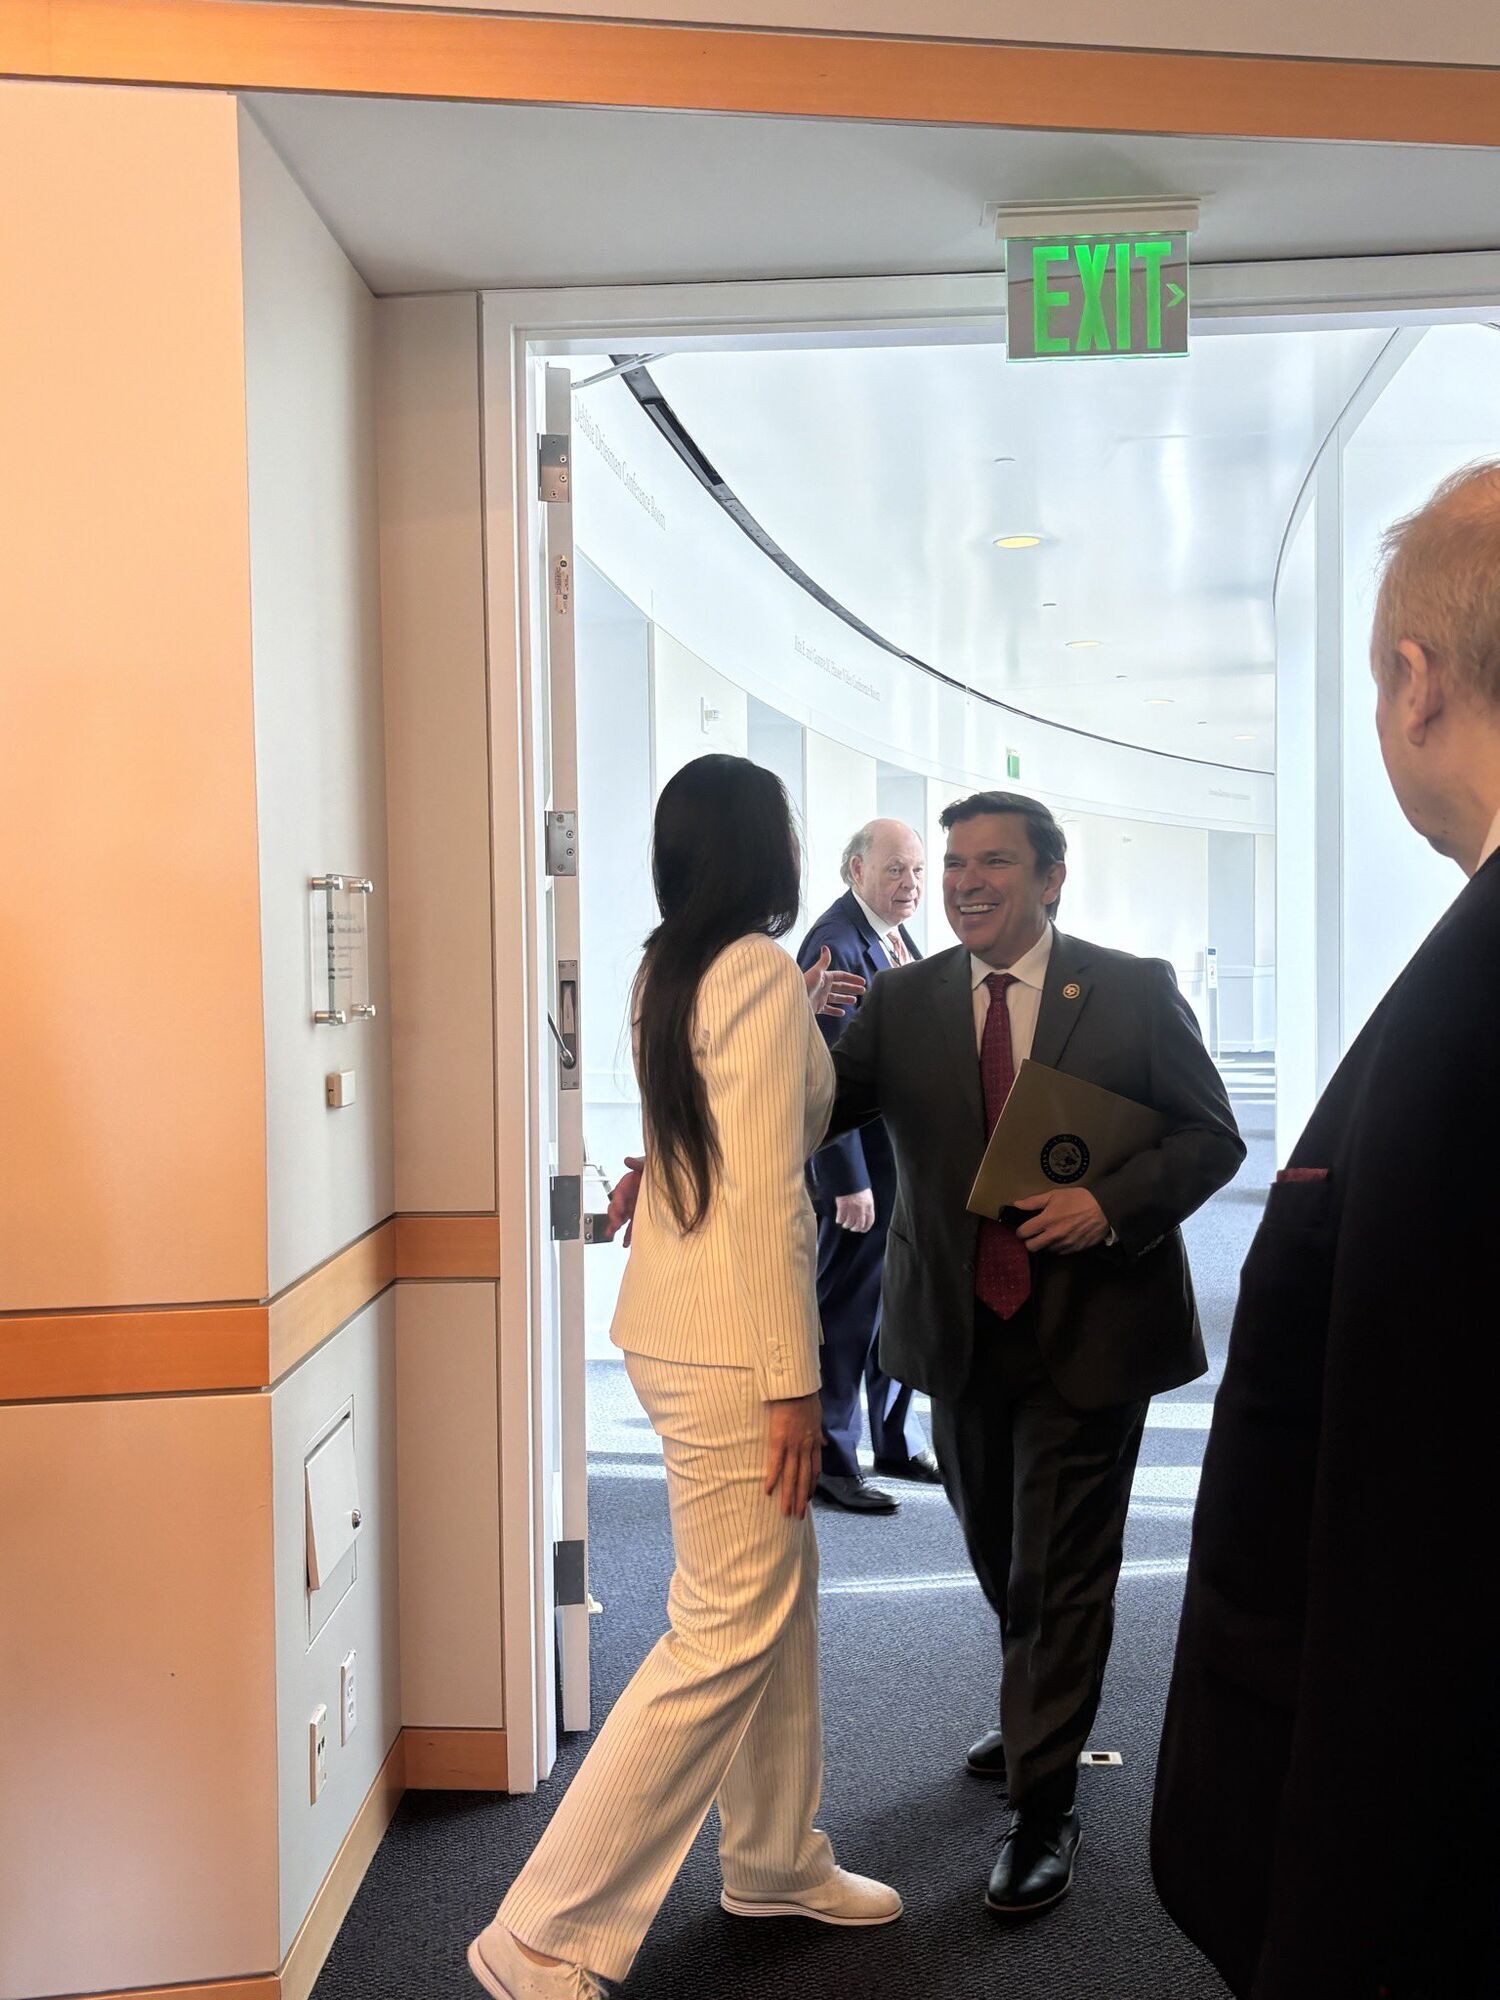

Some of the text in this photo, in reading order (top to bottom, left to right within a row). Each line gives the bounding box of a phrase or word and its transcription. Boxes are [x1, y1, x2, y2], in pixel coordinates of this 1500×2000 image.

[1033, 241, 1171, 353] EXIT
[622, 461, 651, 514] Conference
[650, 495, 667, 531] Room
